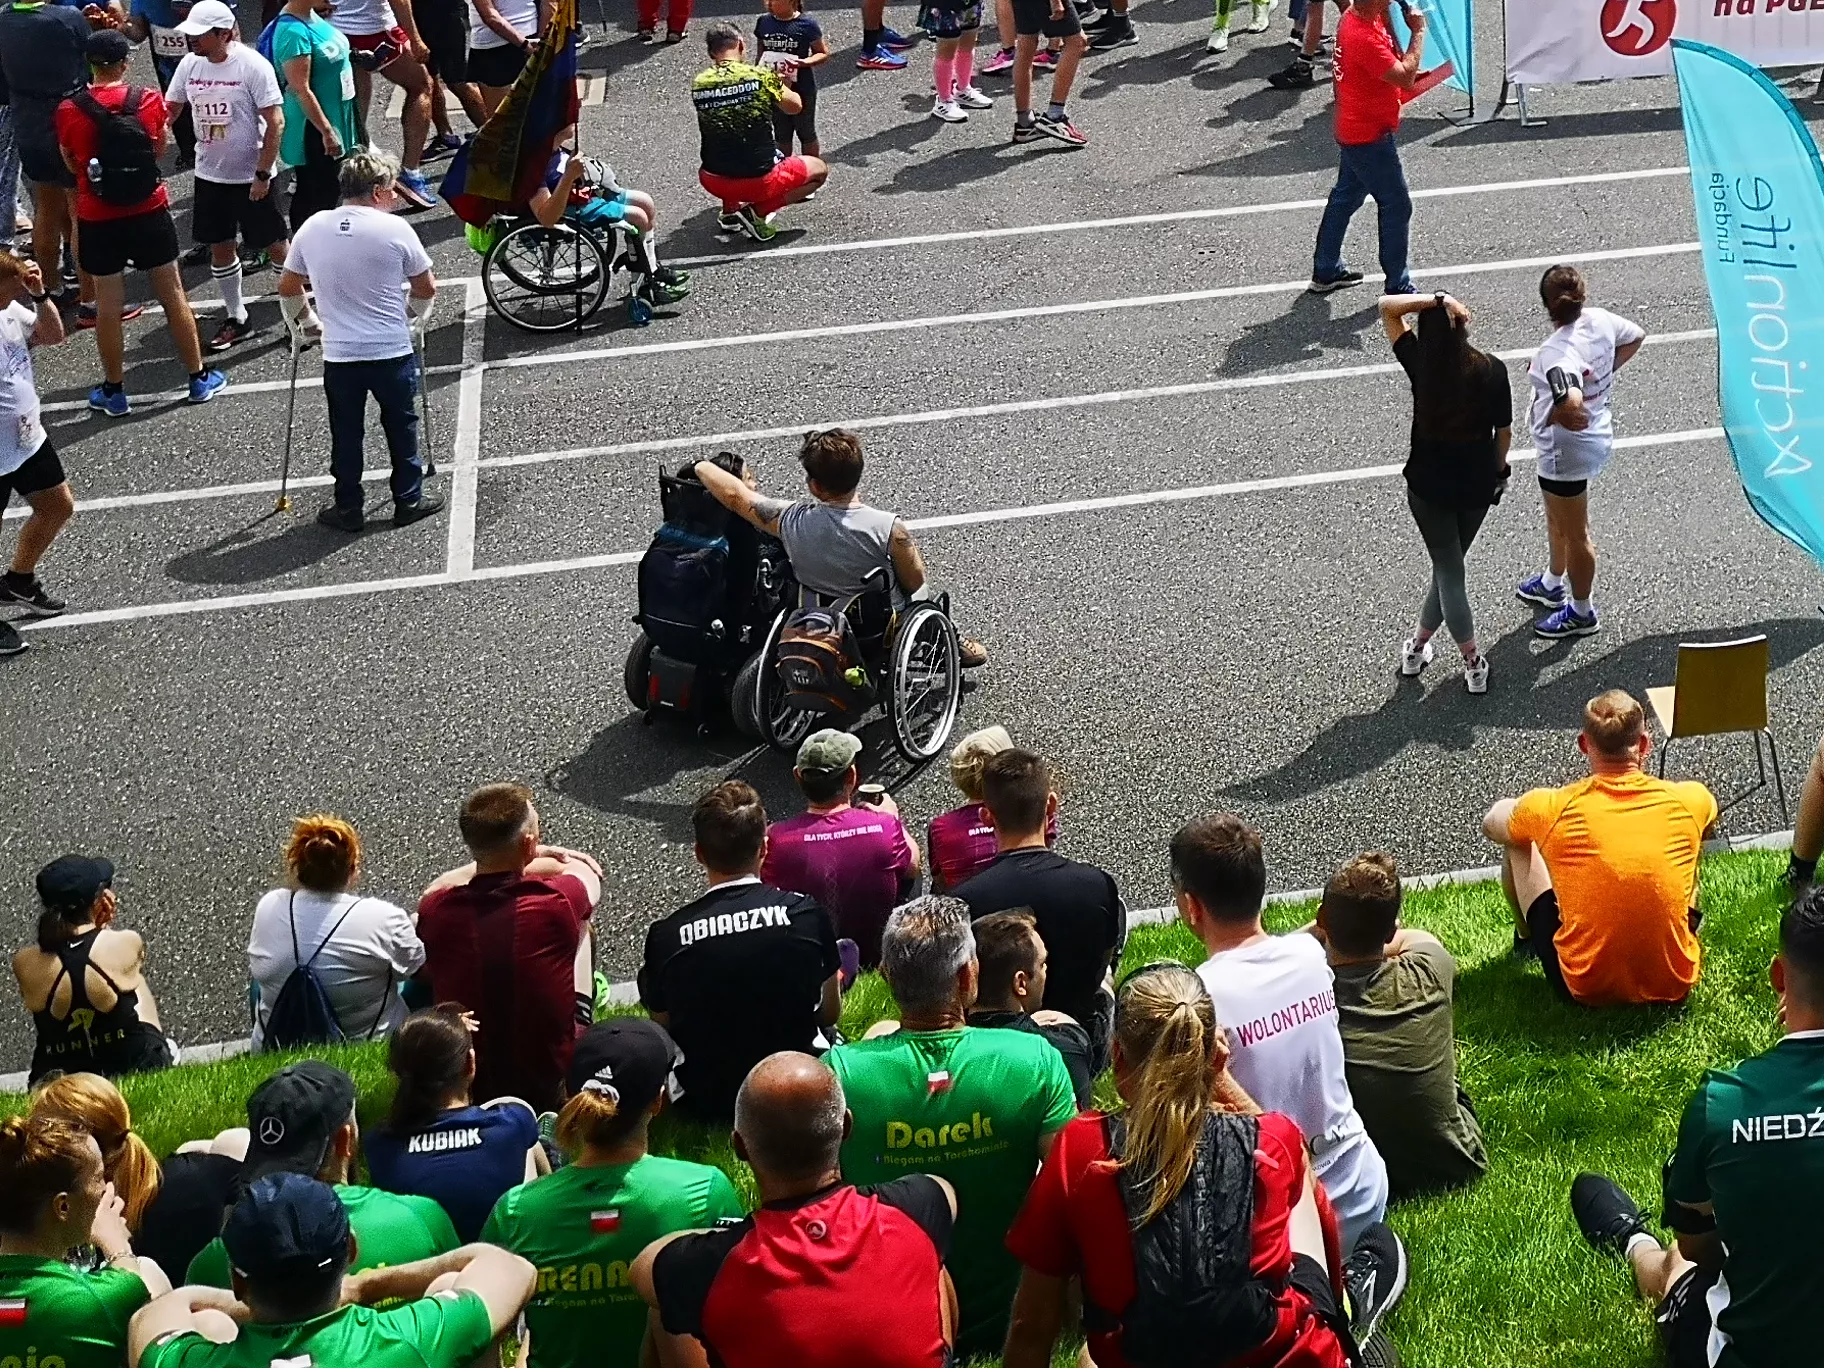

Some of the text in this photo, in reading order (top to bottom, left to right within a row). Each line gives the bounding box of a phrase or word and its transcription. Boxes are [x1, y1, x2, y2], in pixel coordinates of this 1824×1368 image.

[162, 36, 184, 48] 255
[204, 103, 228, 116] 112
[45, 1028, 125, 1056] RUNNER
[408, 1127, 483, 1154] KUBIAK
[886, 1111, 994, 1149] Darek
